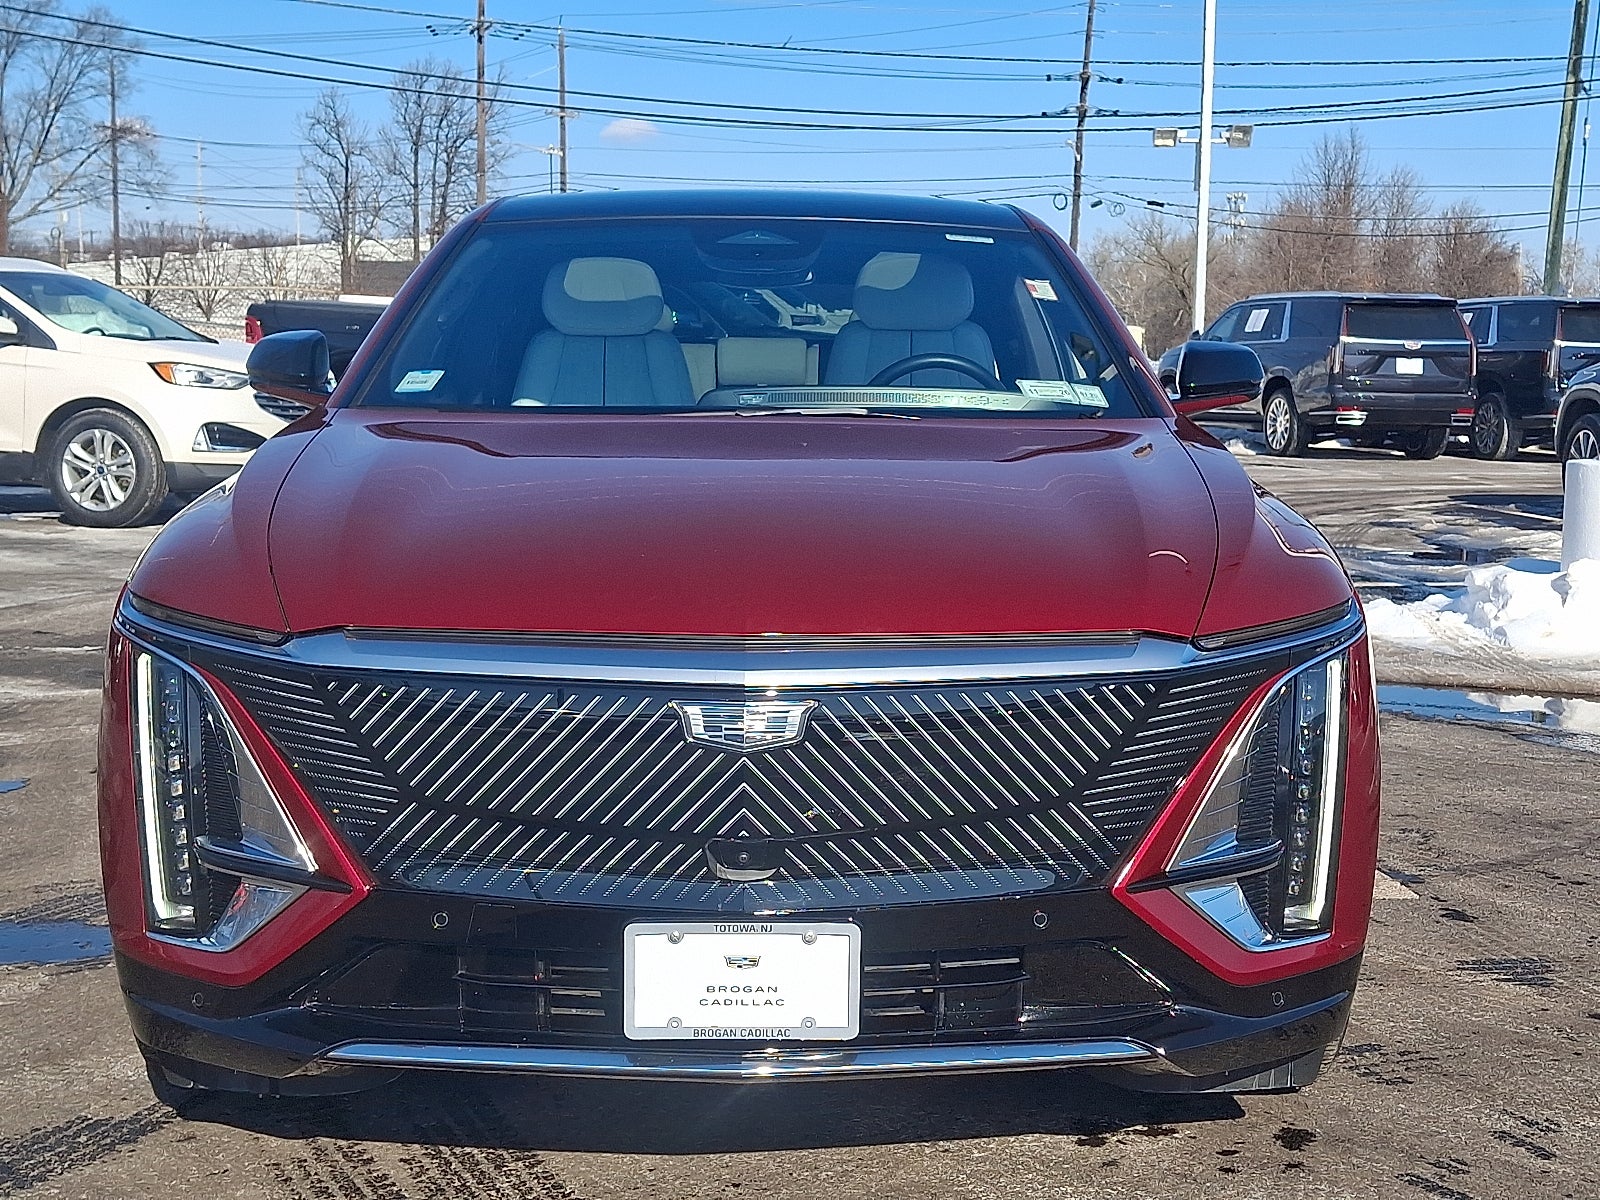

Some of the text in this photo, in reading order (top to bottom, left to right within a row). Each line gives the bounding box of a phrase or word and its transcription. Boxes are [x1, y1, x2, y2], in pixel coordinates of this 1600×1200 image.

[760, 924, 773, 933] NJ
[706, 985, 778, 993] BROGAN
[699, 998, 785, 1007] CADILLAC
[693, 1028, 791, 1038] BROGAN CADILLAC
